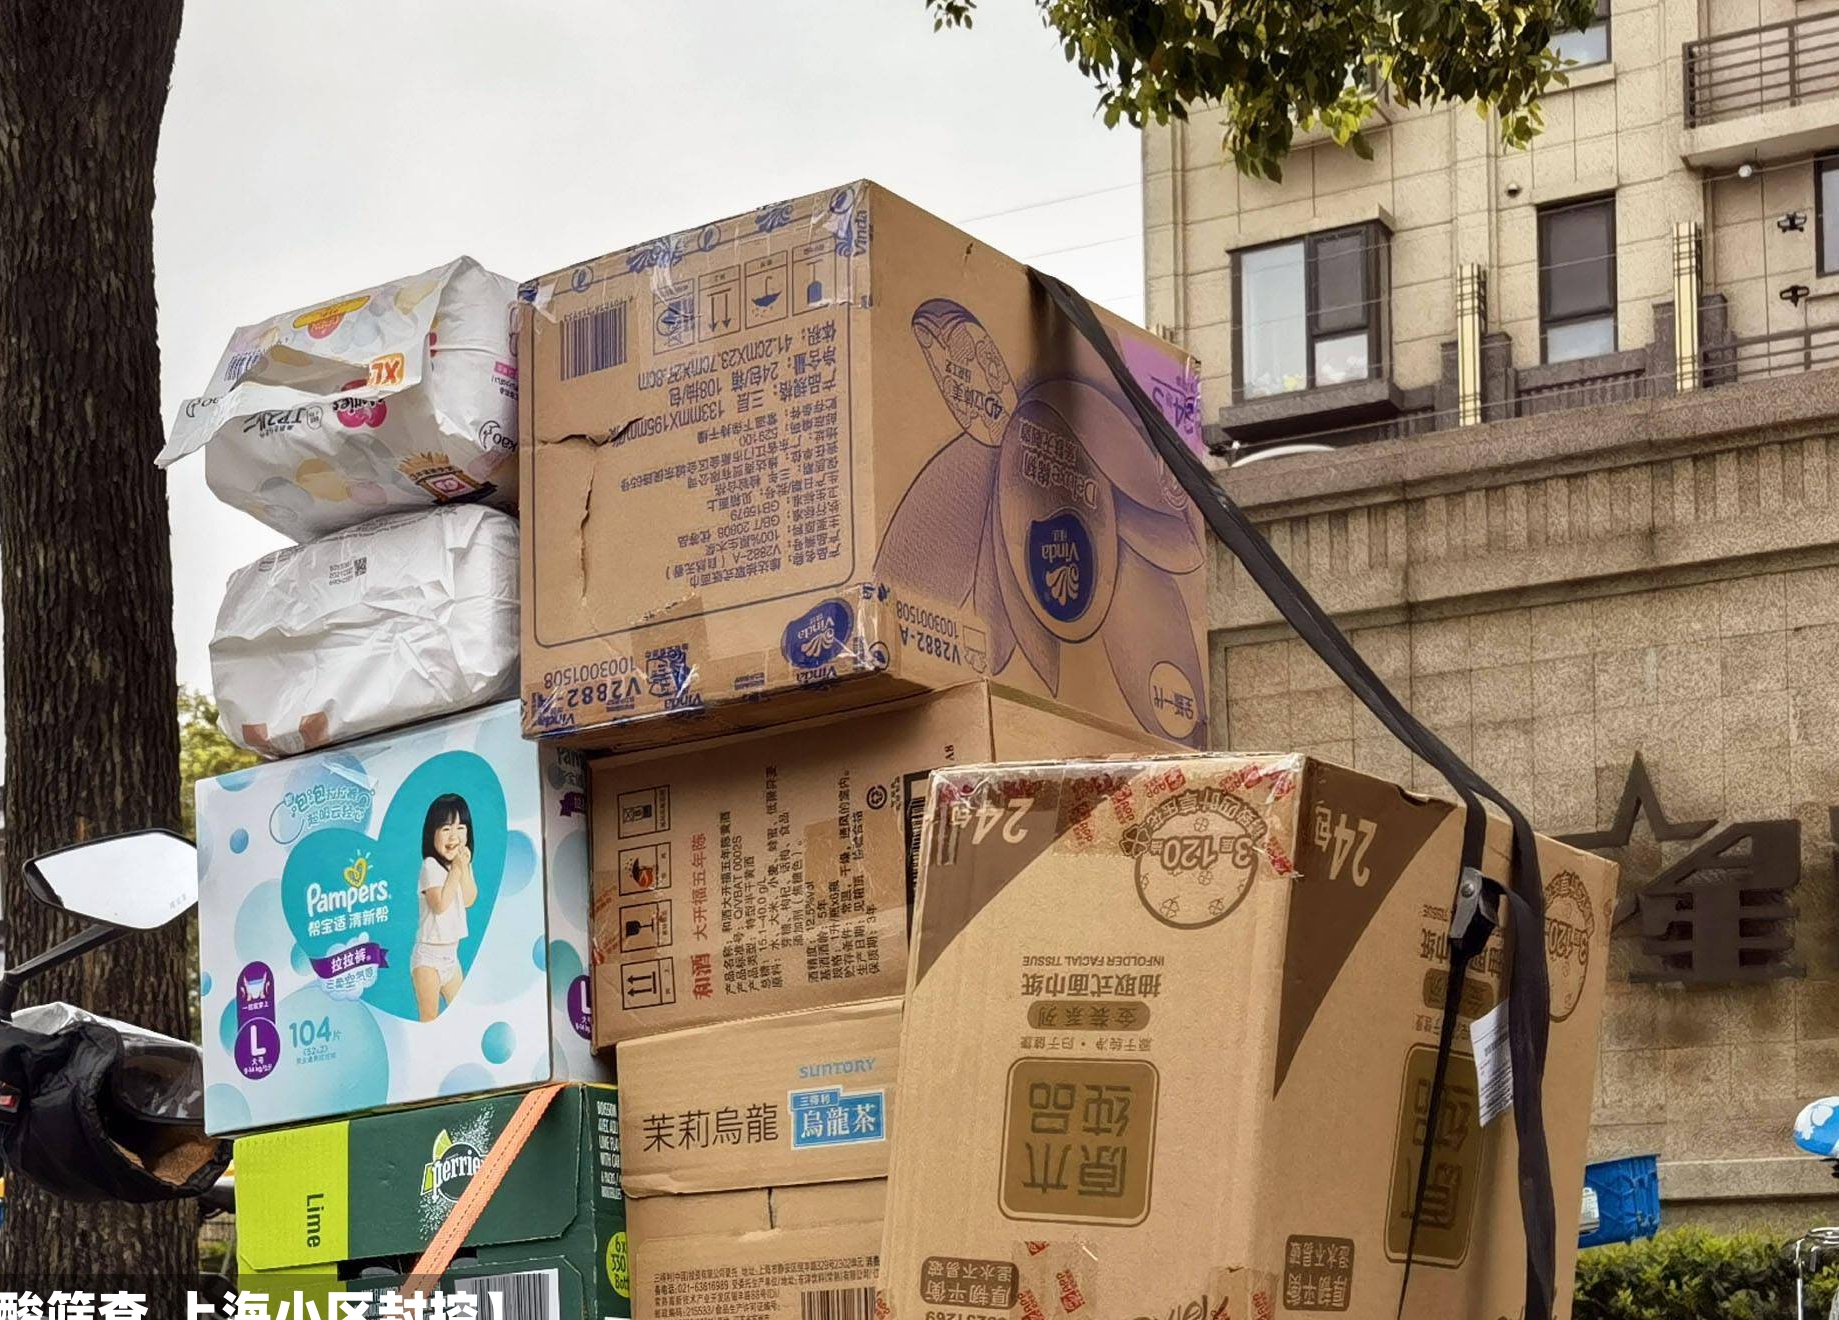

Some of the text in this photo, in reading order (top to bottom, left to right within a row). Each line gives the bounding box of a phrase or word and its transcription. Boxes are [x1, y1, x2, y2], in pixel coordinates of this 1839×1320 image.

[371, 359, 400, 385] XL
[1041, 541, 1080, 562] Vinda
[895, 600, 960, 639] 1003001508
[898, 623, 963, 668] V2882-A
[543, 655, 637, 685] 1003001508
[1311, 804, 1378, 888] 24包
[307, 879, 389, 917] Pampers
[307, 907, 389, 938] 帮宝适 清新帮
[691, 832, 712, 1000] 和酒 大开福五年陈
[331, 948, 366, 973] 拉拉裤
[1022, 955, 1165, 967] INFOLDER FACIAL TISSUE
[1021, 973, 1162, 998] 抽取式面巾纸
[1038, 1005, 1138, 1028] 金装系列
[251, 1025, 266, 1056] L
[1028, 1082, 1132, 1136] 纯品
[642, 1103, 876, 1153] 茉莉烏龍 烏龍茶
[1023, 1141, 1128, 1198] 原木
[306, 1192, 324, 1248] Lime
[1284, 1238, 1350, 1271] 湿水不易破
[927, 1260, 1013, 1283] 湿水不易破
[924, 1281, 1012, 1307] 厚韧平衡
[1284, 1270, 1348, 1308] 厚韧平衡
